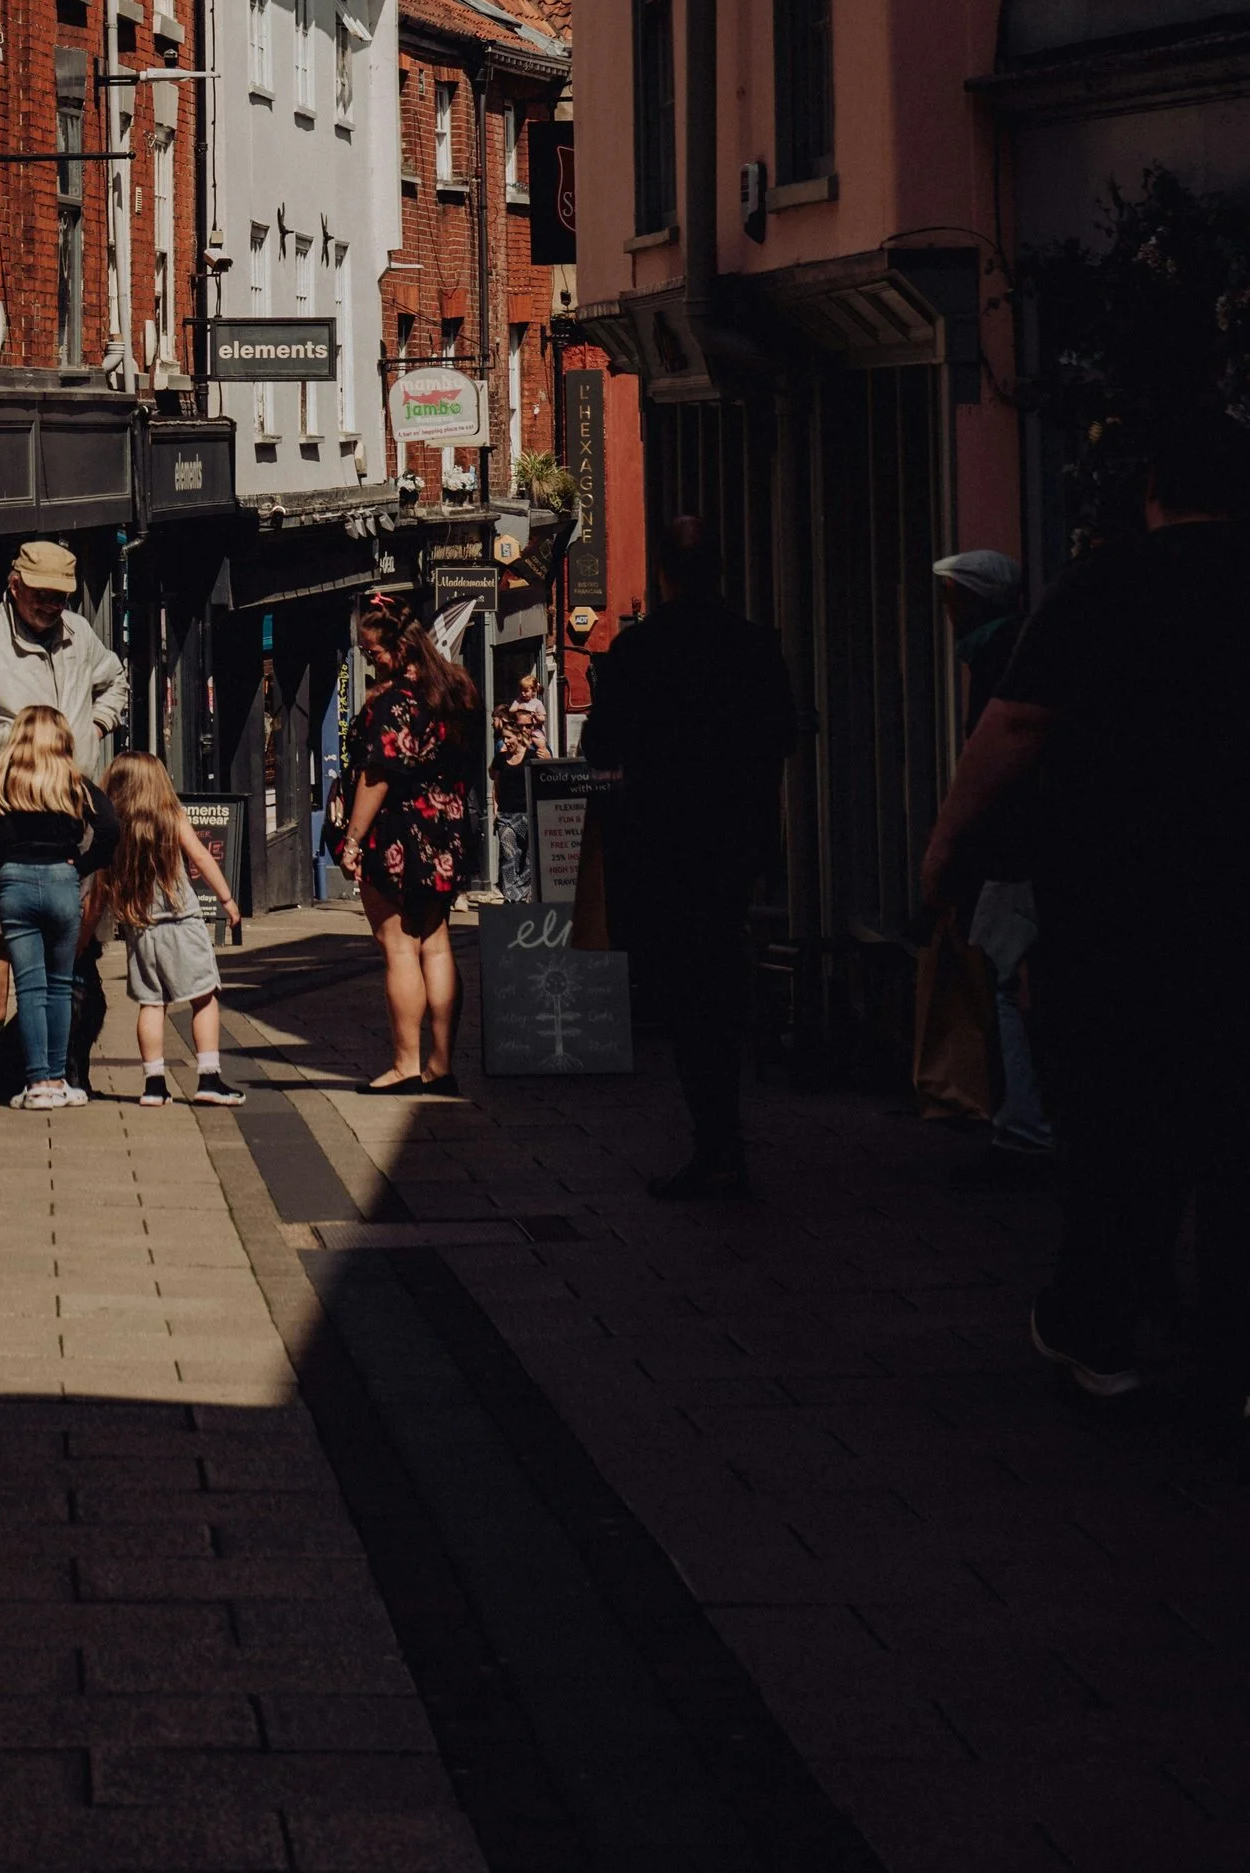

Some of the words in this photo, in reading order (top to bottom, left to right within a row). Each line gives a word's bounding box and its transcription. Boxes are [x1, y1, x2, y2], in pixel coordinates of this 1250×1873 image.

[218, 340, 328, 359] elements
[405, 400, 461, 419] jambo
[579, 384, 594, 544] L'HEXAGONE
[540, 772, 569, 782] Could
[571, 774, 590, 783] you
[570, 784, 593, 793] with
[555, 803, 586, 811] FLEXIBIL
[544, 829, 563, 837] FREE
[553, 878, 578, 886] TRAVE
